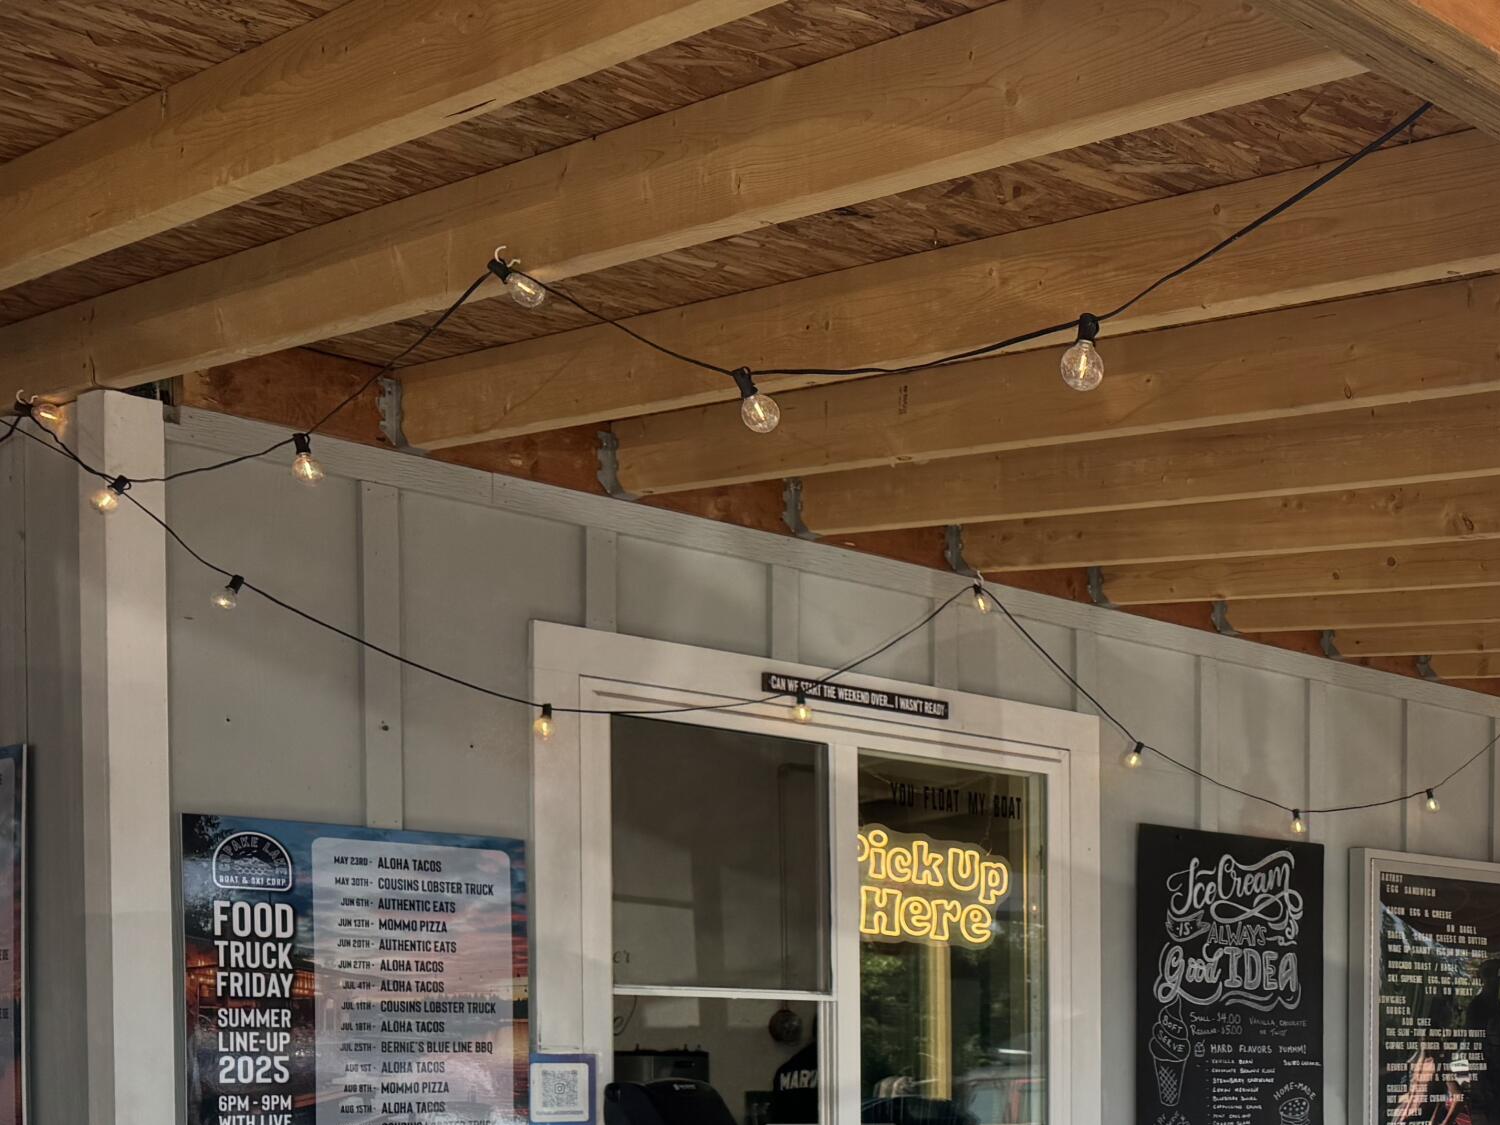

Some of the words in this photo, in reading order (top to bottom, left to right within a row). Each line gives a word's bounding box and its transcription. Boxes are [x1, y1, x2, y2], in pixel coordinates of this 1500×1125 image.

[770, 675, 785, 691] CAN
[823, 684, 837, 697] THE
[837, 686, 870, 704] WEEKEND
[870, 690, 894, 708] OVER...
[899, 695, 923, 712] WASN'T
[924, 701, 946, 716] READY
[891, 782, 914, 807] YOU
[923, 786, 959, 812] FLOAT
[968, 791, 985, 816] MY
[994, 795, 1022, 820] BOAT
[334, 856, 349, 864] MAY
[378, 857, 410, 870] ALOHA
[413, 860, 442, 872] TACOS
[948, 847, 1009, 904] Up
[1167, 857, 1217, 915] Ice
[1217, 850, 1298, 902] Cream
[335, 877, 349, 885] MAY
[378, 878, 419, 891] COUSINS
[422, 881, 462, 895] LOBSTER
[465, 883, 494, 896] TRUCK
[1386, 884, 1399, 893] EGG
[1404, 886, 1436, 897] SANDWICH
[340, 898, 354, 906] JUN
[378, 899, 431, 912] AUTHENTIC
[433, 901, 456, 913] EATS
[1409, 907, 1420, 917] EGG
[1432, 910, 1452, 920] CHEESE
[213, 900, 294, 938] FOOD
[860, 885, 992, 943] Here
[338, 919, 351, 927] JUN
[379, 919, 417, 932] MOMMO
[420, 921, 447, 933] PIZZA
[1206, 921, 1267, 946] ALWAYS
[337, 939, 351, 947] JUN
[379, 939, 431, 952] AUTHENTIC
[434, 941, 457, 953] EATS
[1436, 934, 1456, 944] CHEESE
[214, 940, 293, 969] TRUCK
[338, 960, 352, 968] JUN
[380, 960, 412, 972] ALOHA
[415, 960, 444, 973] TACOS
[1223, 946, 1298, 992] IDEA
[1414, 961, 1432, 971] TOAST
[216, 971, 294, 998] FRIDAY
[343, 981, 357, 989] JUL
[380, 980, 412, 992] ALOHA
[415, 981, 445, 993] TACOS
[341, 1002, 353, 1010] JUL
[380, 1001, 422, 1013] COUSINS
[424, 1001, 464, 1013] LOBSTER
[467, 1002, 496, 1014] TRUCK
[217, 1008, 292, 1028] SUMMER
[341, 1023, 353, 1031] JUL
[381, 1021, 413, 1033] ALOHA
[415, 1021, 445, 1033] TACOS
[218, 1031, 290, 1052] LINE-UP
[339, 1043, 353, 1052] JUL
[381, 1041, 424, 1053] BERNIE'S
[427, 1041, 450, 1053] BLUE
[453, 1041, 473, 1053] LINE
[475, 1041, 493, 1054] BBQ
[1157, 1030, 1185, 1052] SERVE
[1211, 1044, 1233, 1054] HARD
[1239, 1044, 1273, 1054] FLAVORS
[218, 1055, 290, 1084] 2025
[345, 1064, 360, 1072] AUG
[381, 1062, 413, 1074] ALOHA
[416, 1061, 445, 1073] TACOS
[343, 1085, 358, 1093] AUG
[381, 1082, 420, 1094] MOMMO
[422, 1082, 449, 1093] PIZZA
[218, 1095, 249, 1111] 6PM
[261, 1095, 292, 1111] 9PM
[340, 1105, 355, 1114] AUG
[381, 1102, 413, 1114] ALOHA
[416, 1101, 445, 1113] TACOS
